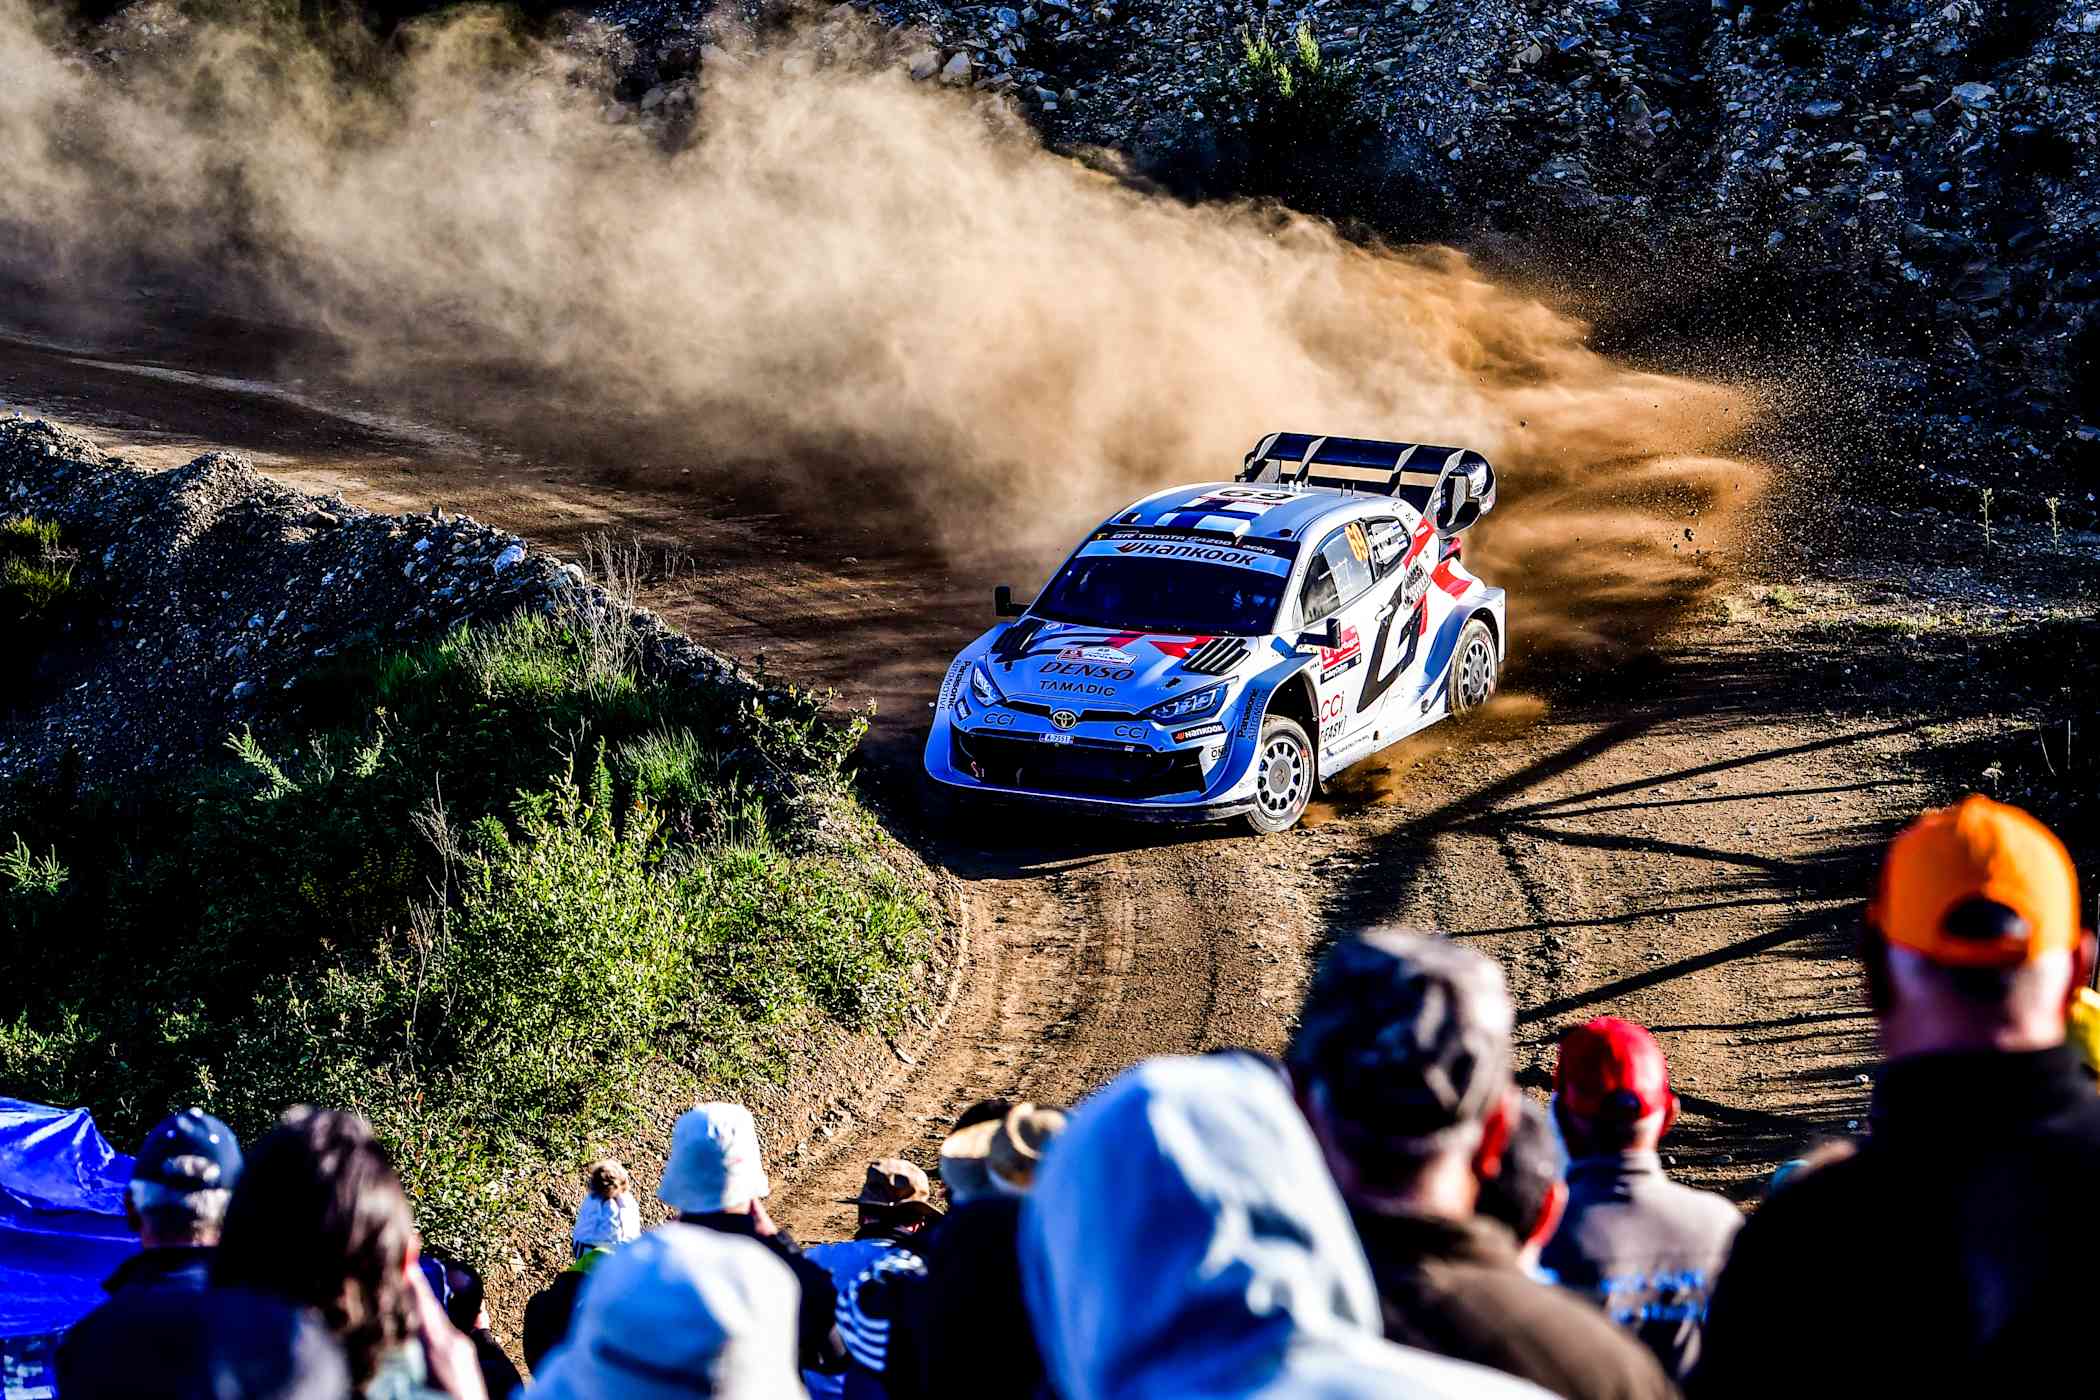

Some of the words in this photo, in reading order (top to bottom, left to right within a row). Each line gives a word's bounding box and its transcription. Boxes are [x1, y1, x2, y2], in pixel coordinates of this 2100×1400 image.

[1138, 533, 1185, 541] TOYOTA
[1039, 661, 1137, 681] DENSO
[948, 660, 972, 710] Panasonic
[1039, 680, 1117, 697] TAMADIC
